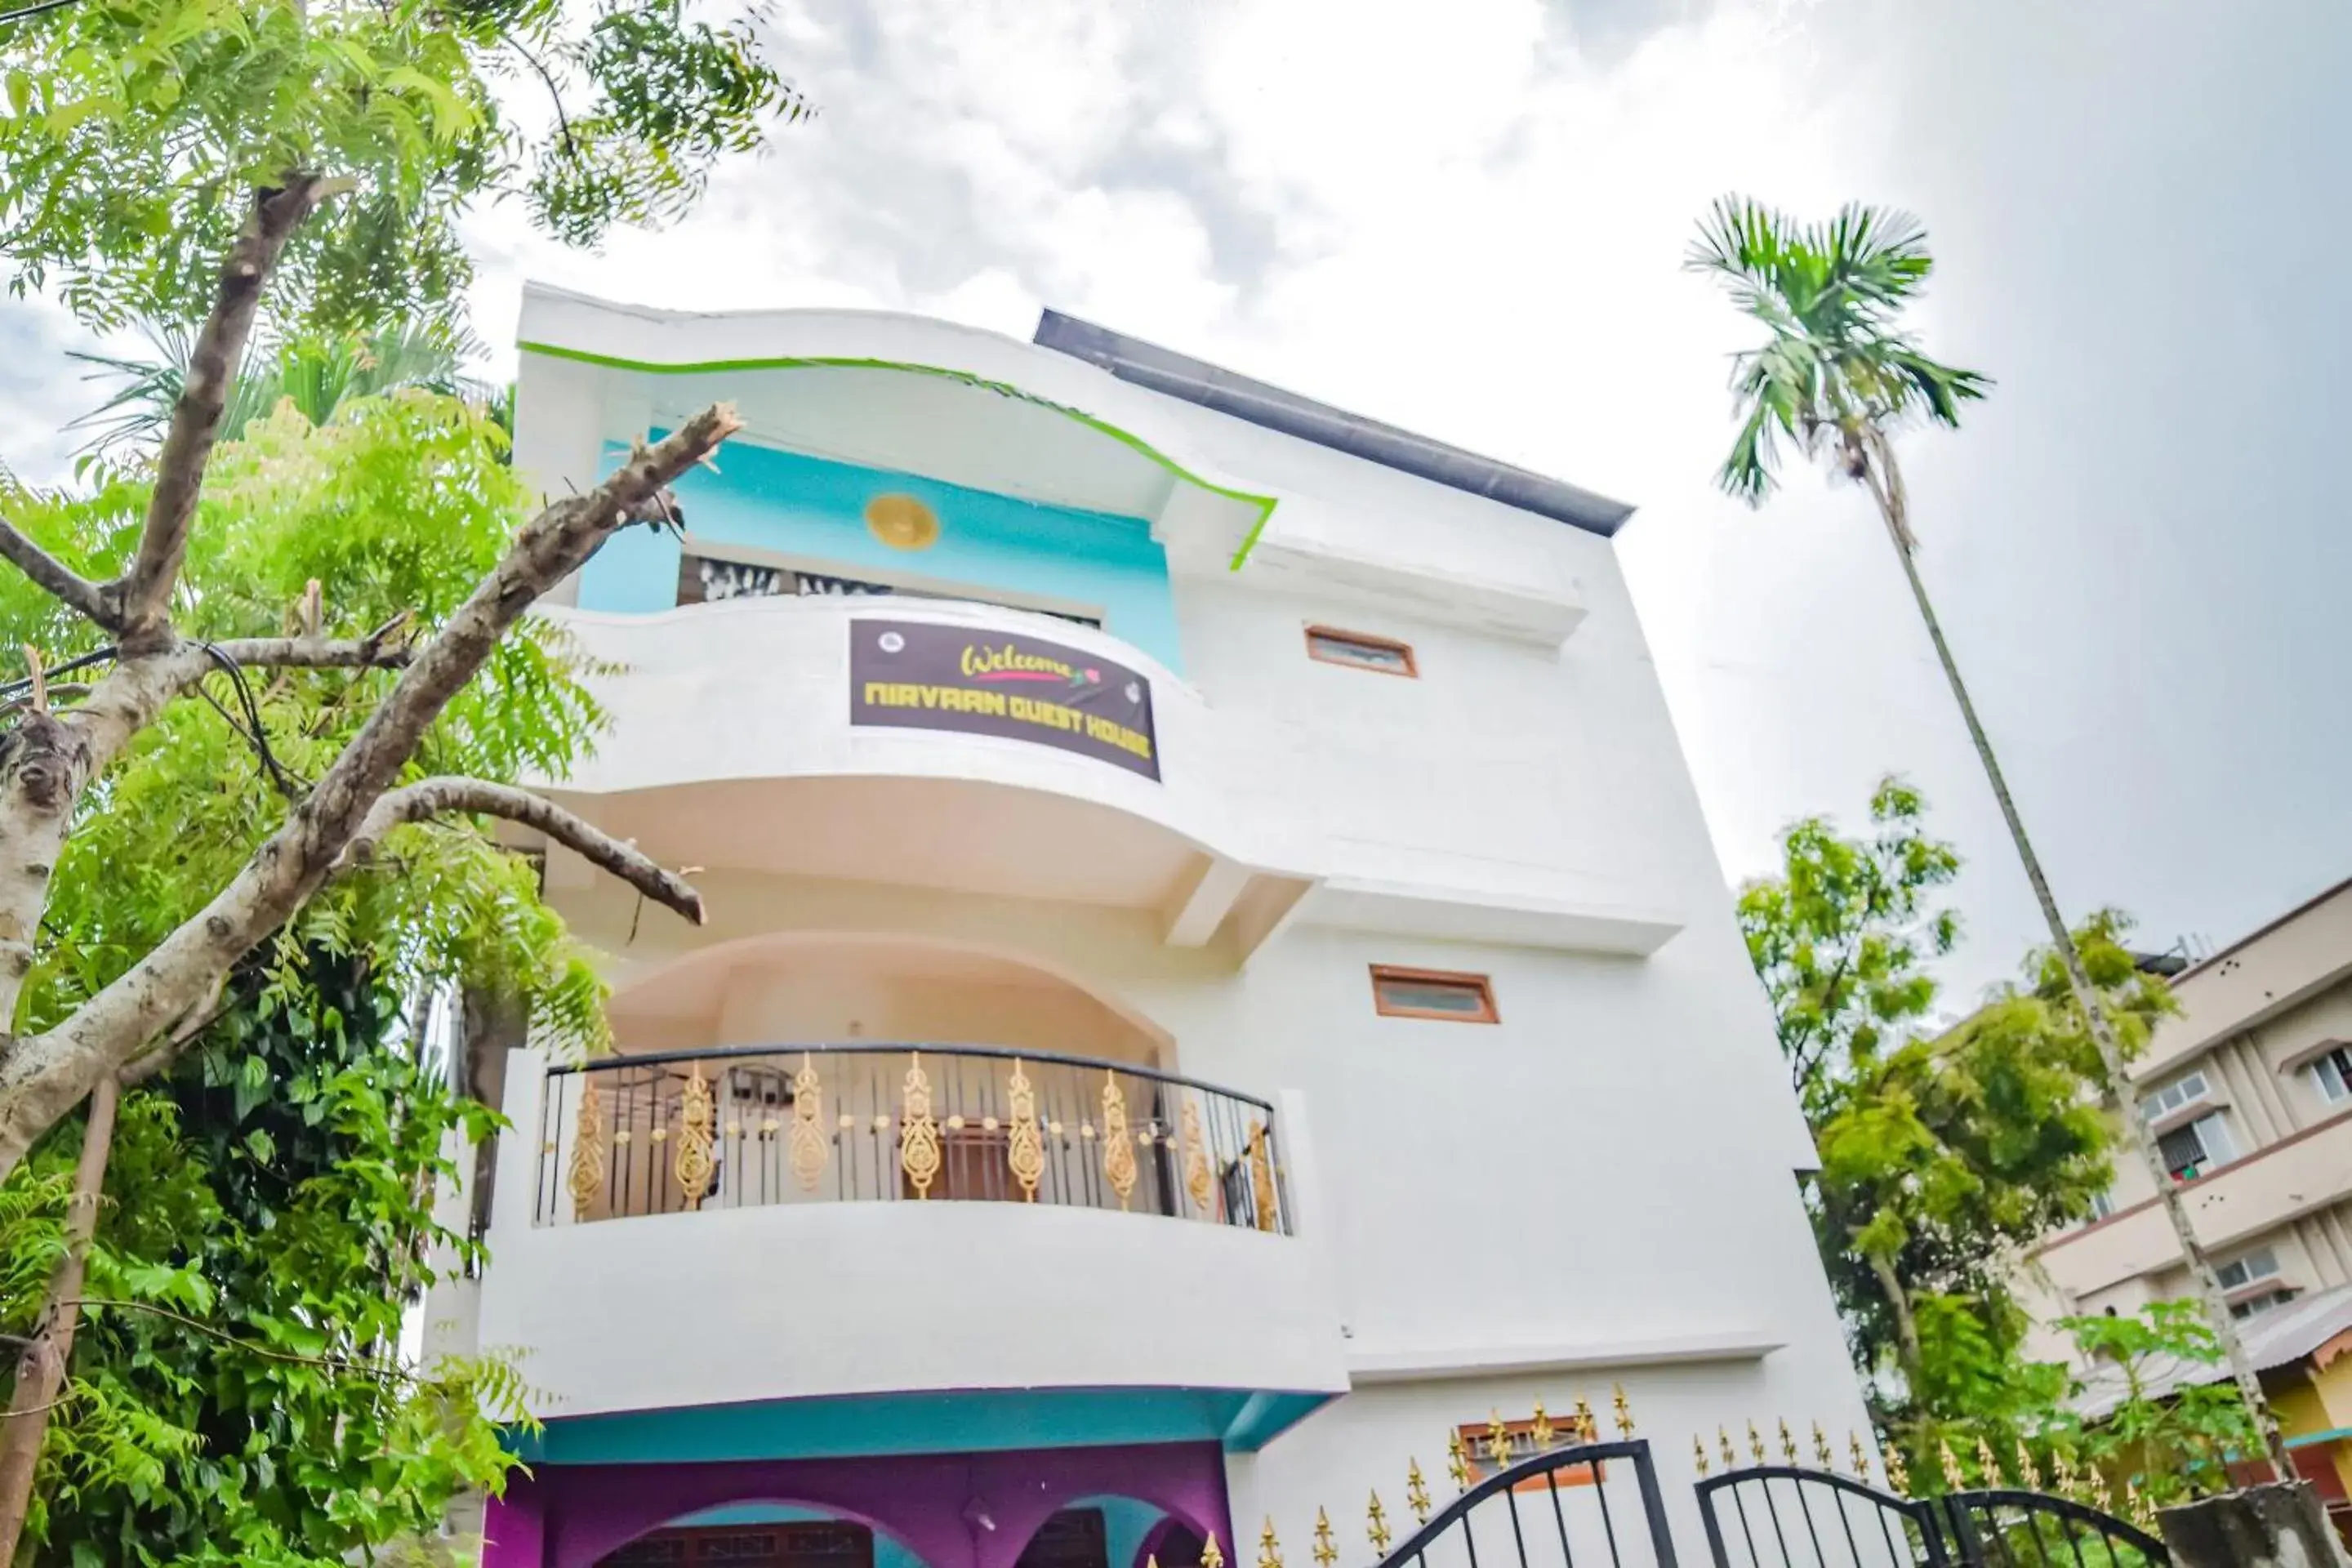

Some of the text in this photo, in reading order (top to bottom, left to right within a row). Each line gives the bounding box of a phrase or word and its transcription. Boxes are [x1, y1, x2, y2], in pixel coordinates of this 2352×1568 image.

[960, 644, 1073, 678] Welcome
[865, 683, 1152, 759] NIRVAAN GUEST HOUSE
